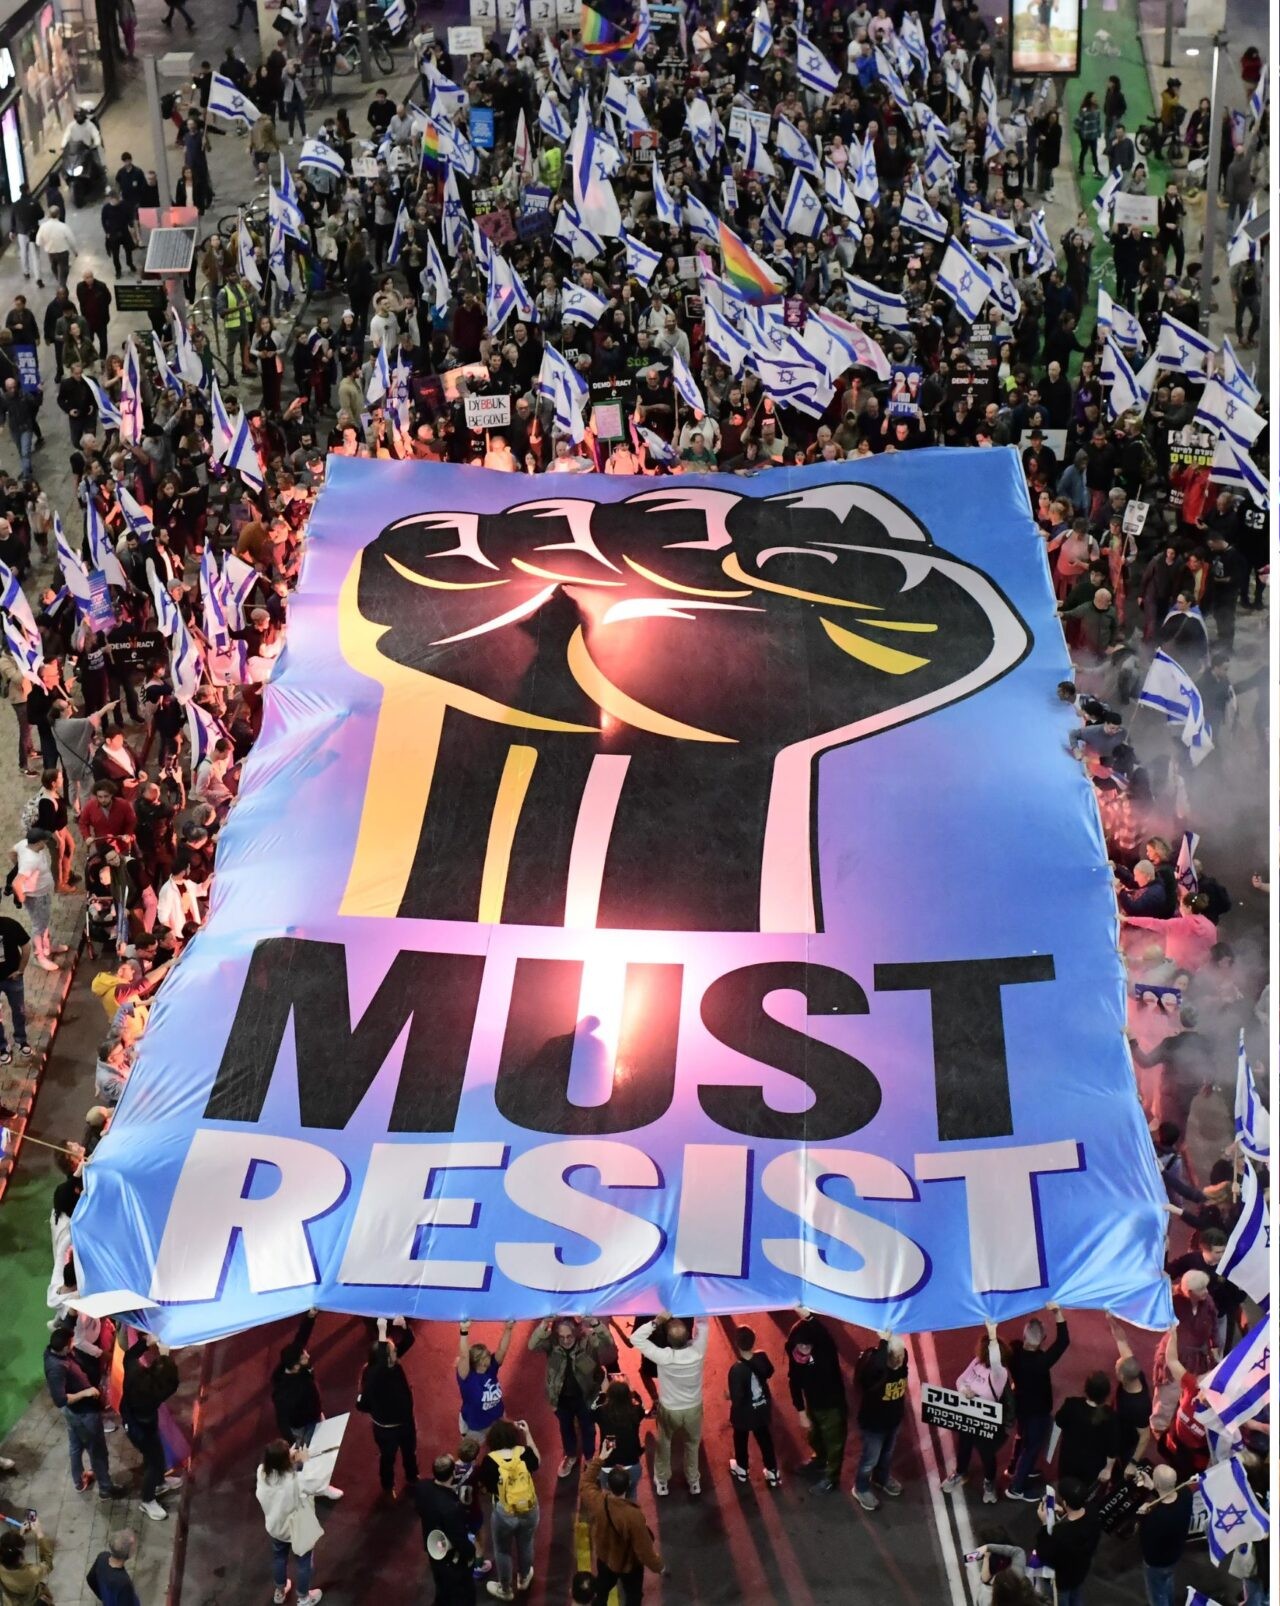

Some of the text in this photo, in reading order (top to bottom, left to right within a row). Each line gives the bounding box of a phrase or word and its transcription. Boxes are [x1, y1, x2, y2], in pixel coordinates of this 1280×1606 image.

[468, 397, 507, 411] DYBBUK
[592, 379, 632, 389] DEMORACY
[202, 937, 1055, 1142] MUST
[150, 1128, 1086, 1304] RESIST
